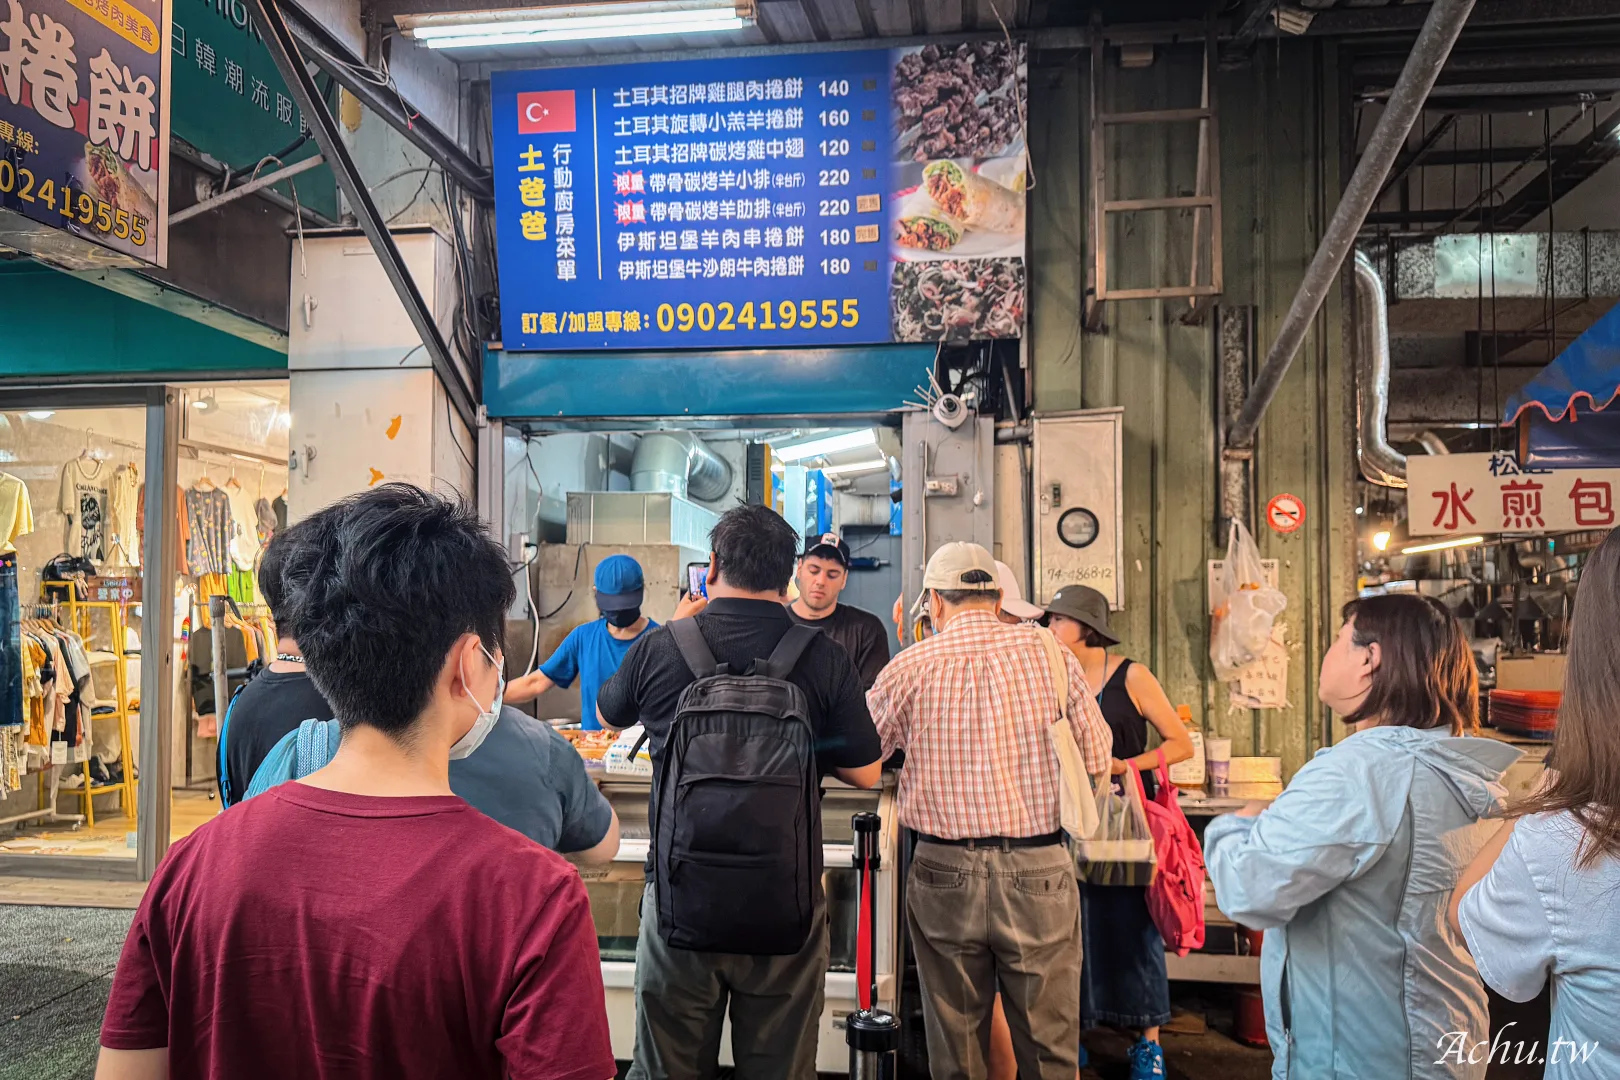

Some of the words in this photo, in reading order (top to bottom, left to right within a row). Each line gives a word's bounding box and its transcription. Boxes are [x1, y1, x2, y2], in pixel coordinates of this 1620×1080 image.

[0, 0, 156, 171] 捲餅
[613, 77, 803, 108] 土耳其招牌雞腿肉捲餅
[818, 80, 849, 97] 140
[614, 107, 804, 137] 土耳其旋轉小羔羊捲餅
[818, 110, 850, 127] 160
[614, 138, 804, 165] 土耳其招牌碳烤雞中翅
[819, 139, 850, 156] 120
[518, 144, 547, 241] 土爸爸
[616, 174, 645, 192] 限量
[819, 170, 850, 186] 220
[553, 143, 577, 282] 行動廚房菜單
[617, 204, 645, 222] 限量
[819, 200, 850, 216] 220
[617, 226, 804, 252] 伊斯坦堡羊肉串捲餅
[820, 229, 850, 245] 180
[618, 255, 804, 281] 伊斯坦堡牛沙朗牛肉捲餅
[820, 258, 850, 275] 180
[521, 310, 650, 334] 訂餐/加盟專線:
[656, 298, 859, 332] 0902419555
[1431, 477, 1615, 530] 水煎包
